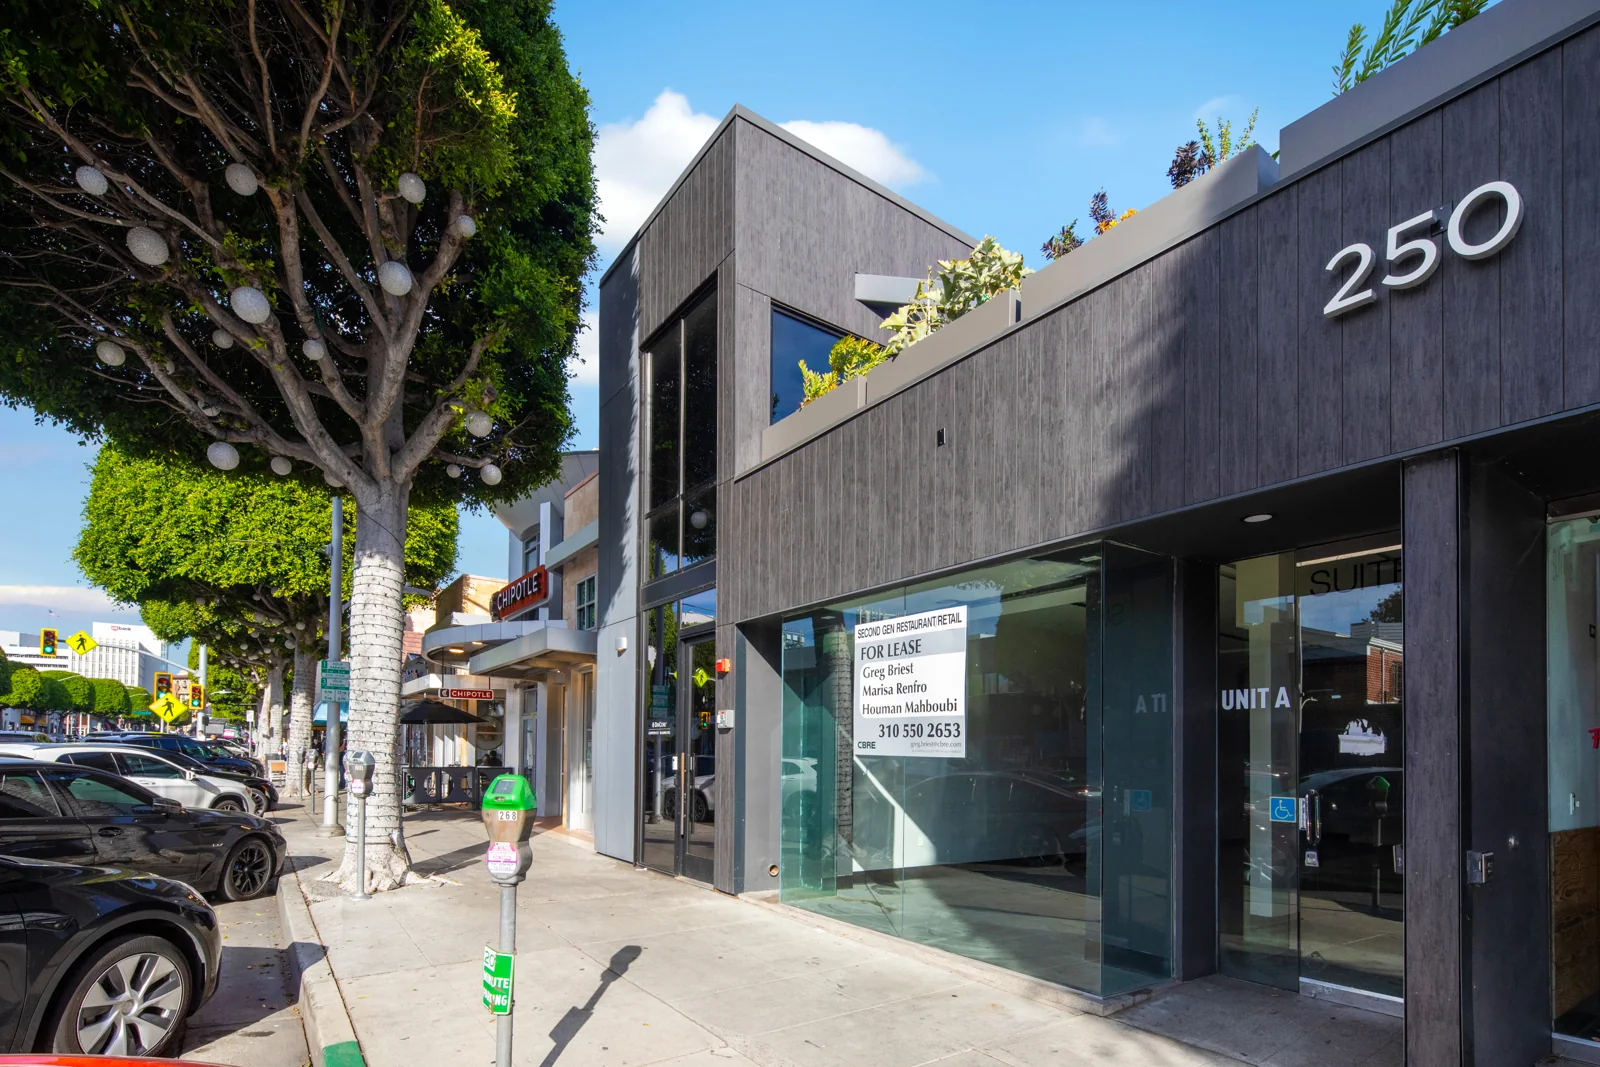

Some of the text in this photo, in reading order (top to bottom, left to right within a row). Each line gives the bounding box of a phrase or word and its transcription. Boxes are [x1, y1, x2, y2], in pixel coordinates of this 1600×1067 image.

[1323, 180, 1524, 318] 250
[497, 572, 538, 610] CHIPOTLE
[857, 612, 962, 639] SECOND GEN RESTAURANT RETAIL
[860, 638, 922, 660] FOR LEASE
[862, 662, 914, 681] Greg Briest
[451, 690, 491, 698] CHIPOTLE
[862, 680, 927, 697] Marisa Renfro
[862, 698, 958, 715] Houman Mahboubi
[1221, 686, 1291, 711] UNIT A
[878, 722, 961, 738] 310 550 2653
[857, 741, 876, 749] CBRE
[499, 811, 517, 820] 268
